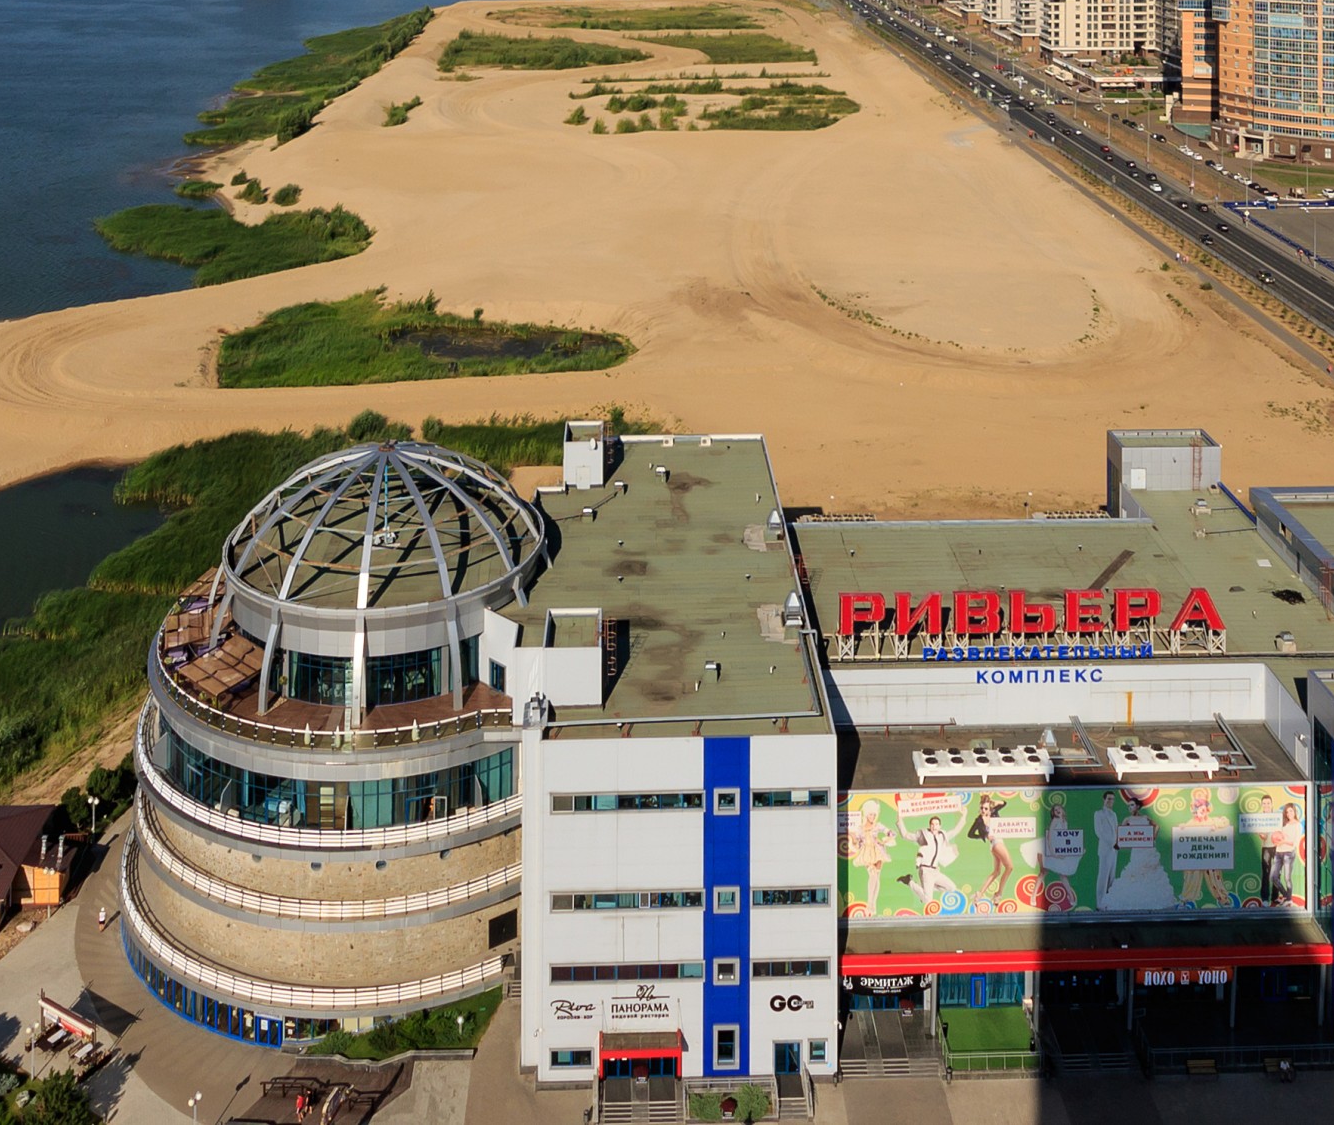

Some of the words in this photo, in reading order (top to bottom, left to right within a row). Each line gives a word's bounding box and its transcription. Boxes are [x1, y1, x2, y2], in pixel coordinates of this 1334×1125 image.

[838, 587, 1226, 636] РИВЬЕРА
[922, 640, 1154, 662] РАЗВЛЕКАТЕЛЬНЫЙ
[976, 668, 1104, 684] КОМПЛЕКС
[910, 799, 948, 807] ВЕСЕЛИМСЯ
[860, 976, 914, 988] ЭРМИТАЖ
[550, 999, 596, 1017] Riva
[611, 1003, 669, 1013] ПАНОРАМА
